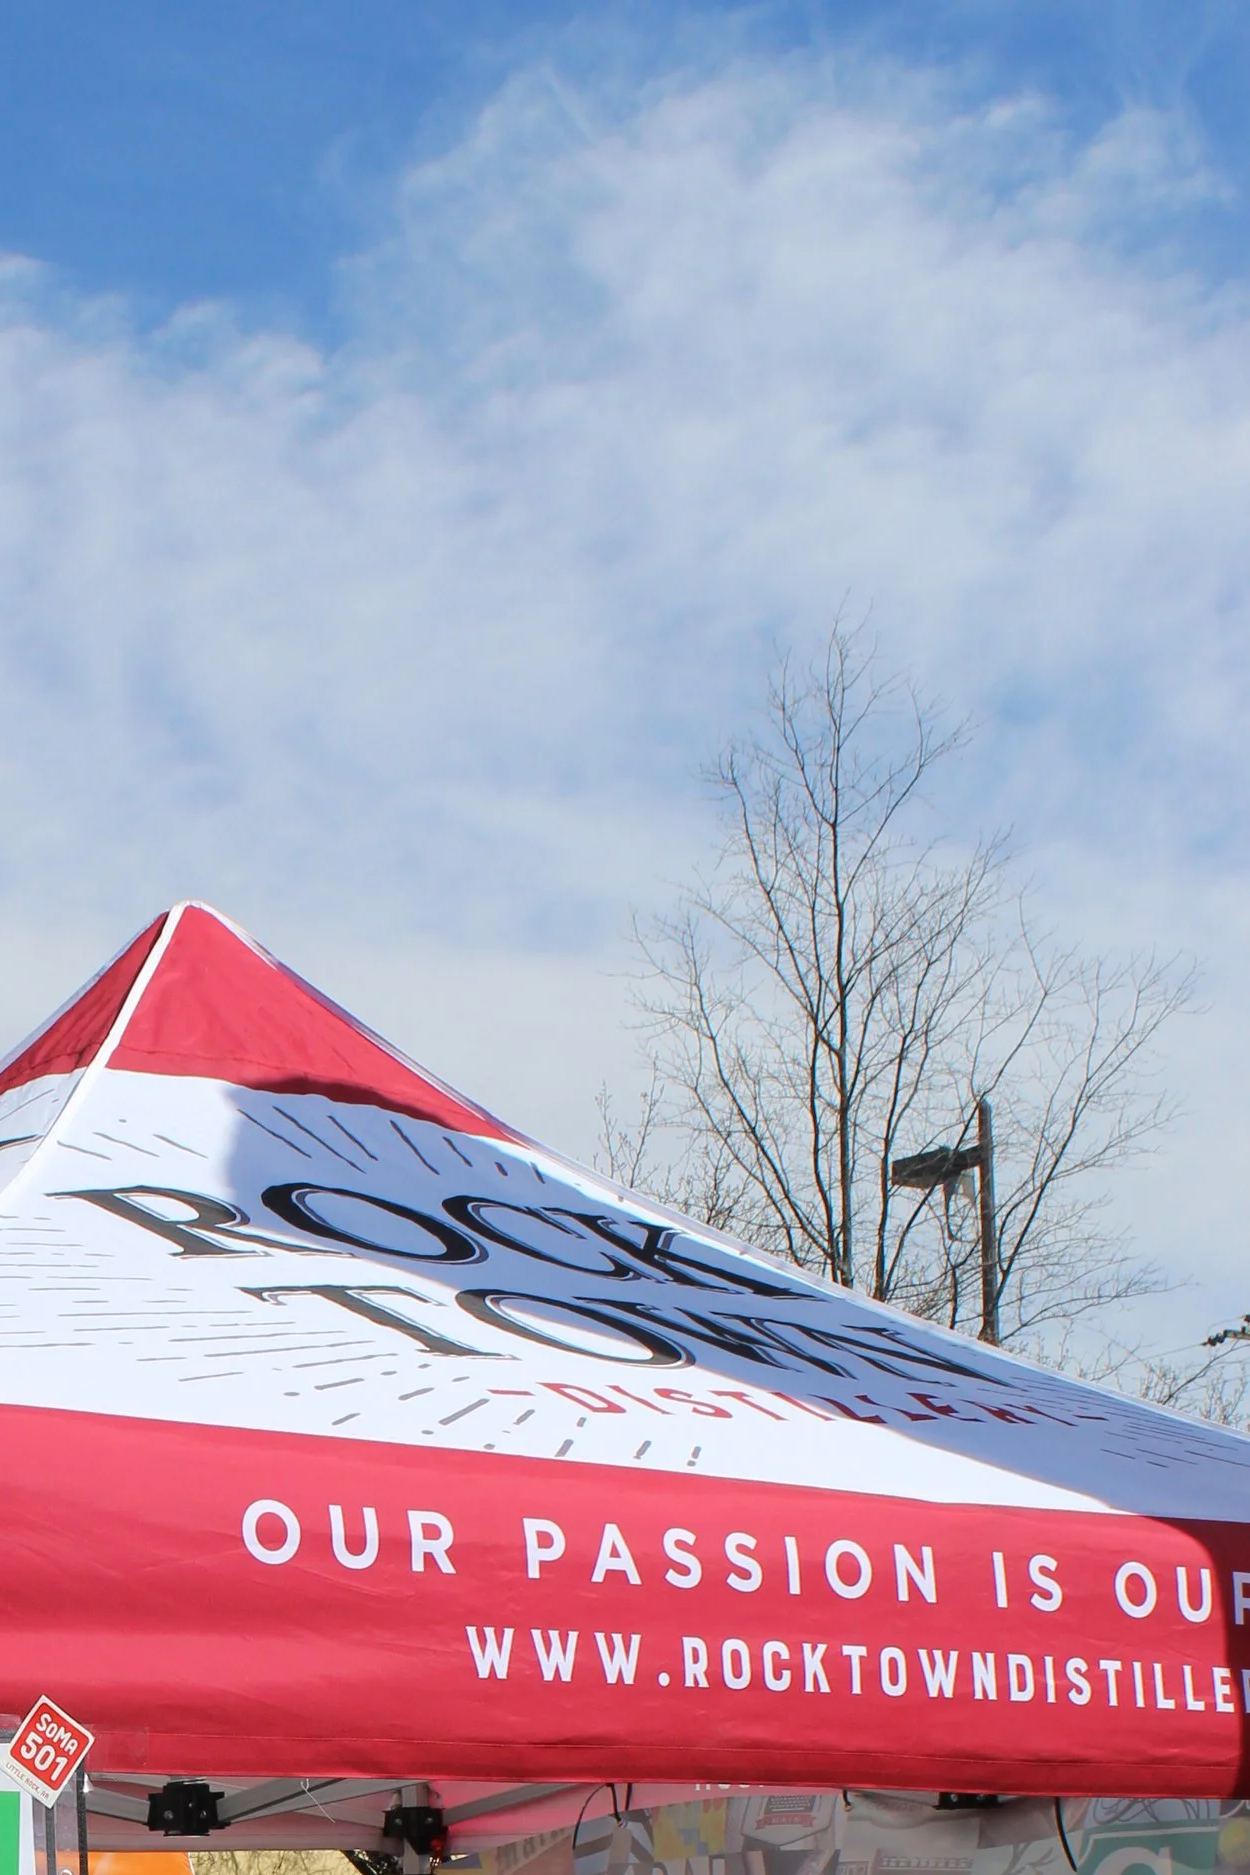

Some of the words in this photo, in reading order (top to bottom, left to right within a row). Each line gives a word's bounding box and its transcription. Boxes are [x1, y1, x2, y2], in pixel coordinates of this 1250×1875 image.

[44, 1180, 826, 1302] ROCK
[238, 1282, 1008, 1386] TOWN
[241, 1498, 457, 1575] OUR
[522, 1517, 938, 1604] PASSION
[991, 1550, 1064, 1612] IS
[20, 1731, 68, 1782] 501
[35, 1713, 79, 1756] SoMA
